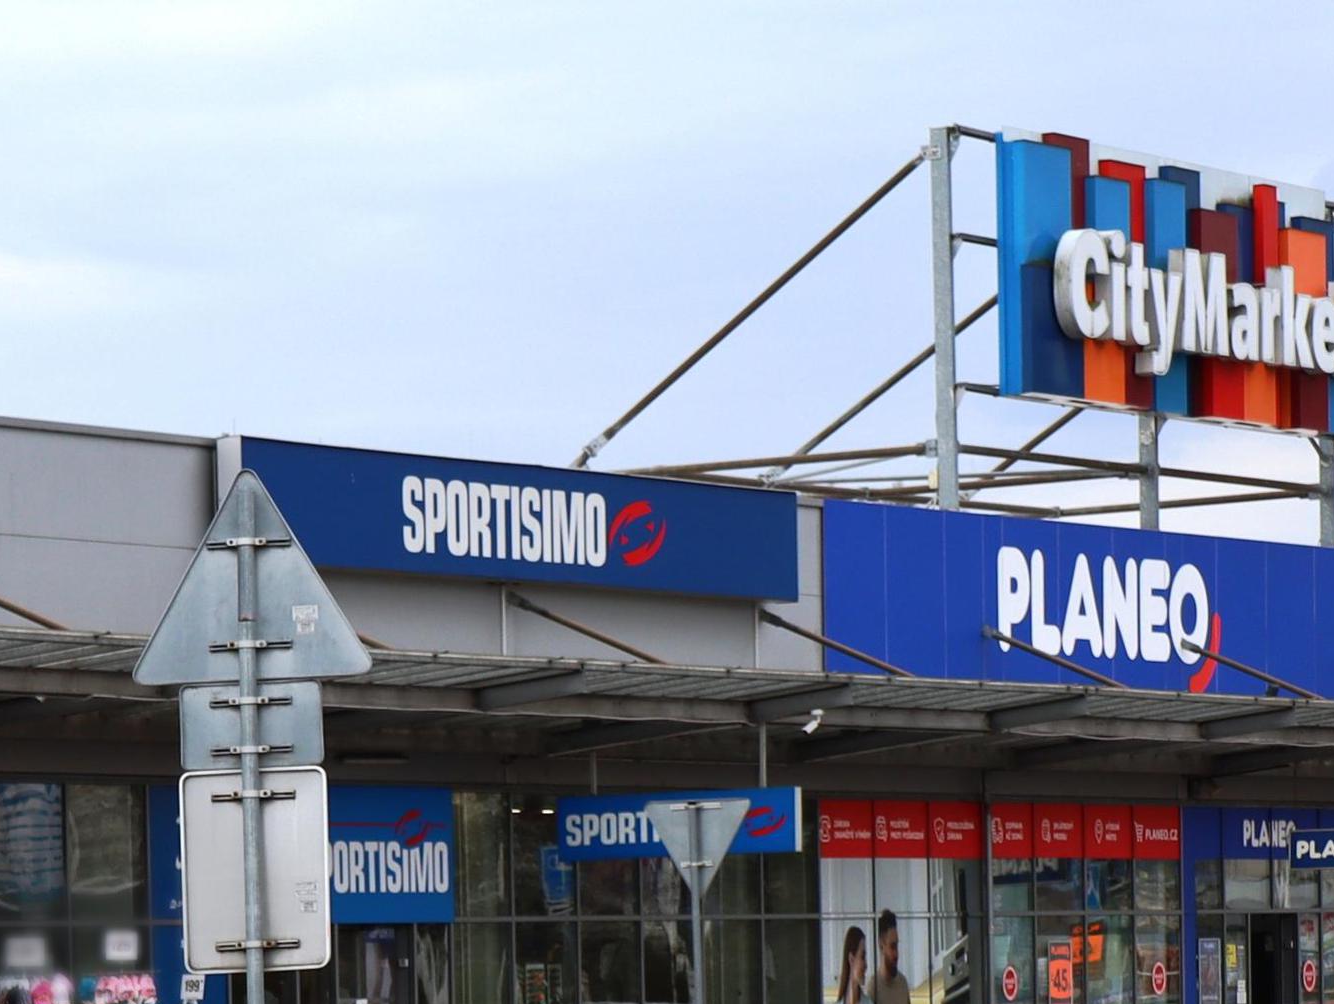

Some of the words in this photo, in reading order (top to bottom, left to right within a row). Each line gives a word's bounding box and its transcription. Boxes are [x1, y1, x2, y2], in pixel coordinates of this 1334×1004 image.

[402, 475, 607, 567] SPORTISIMO
[997, 546, 1210, 665] PLANEO
[329, 840, 450, 893] ORTISIMO
